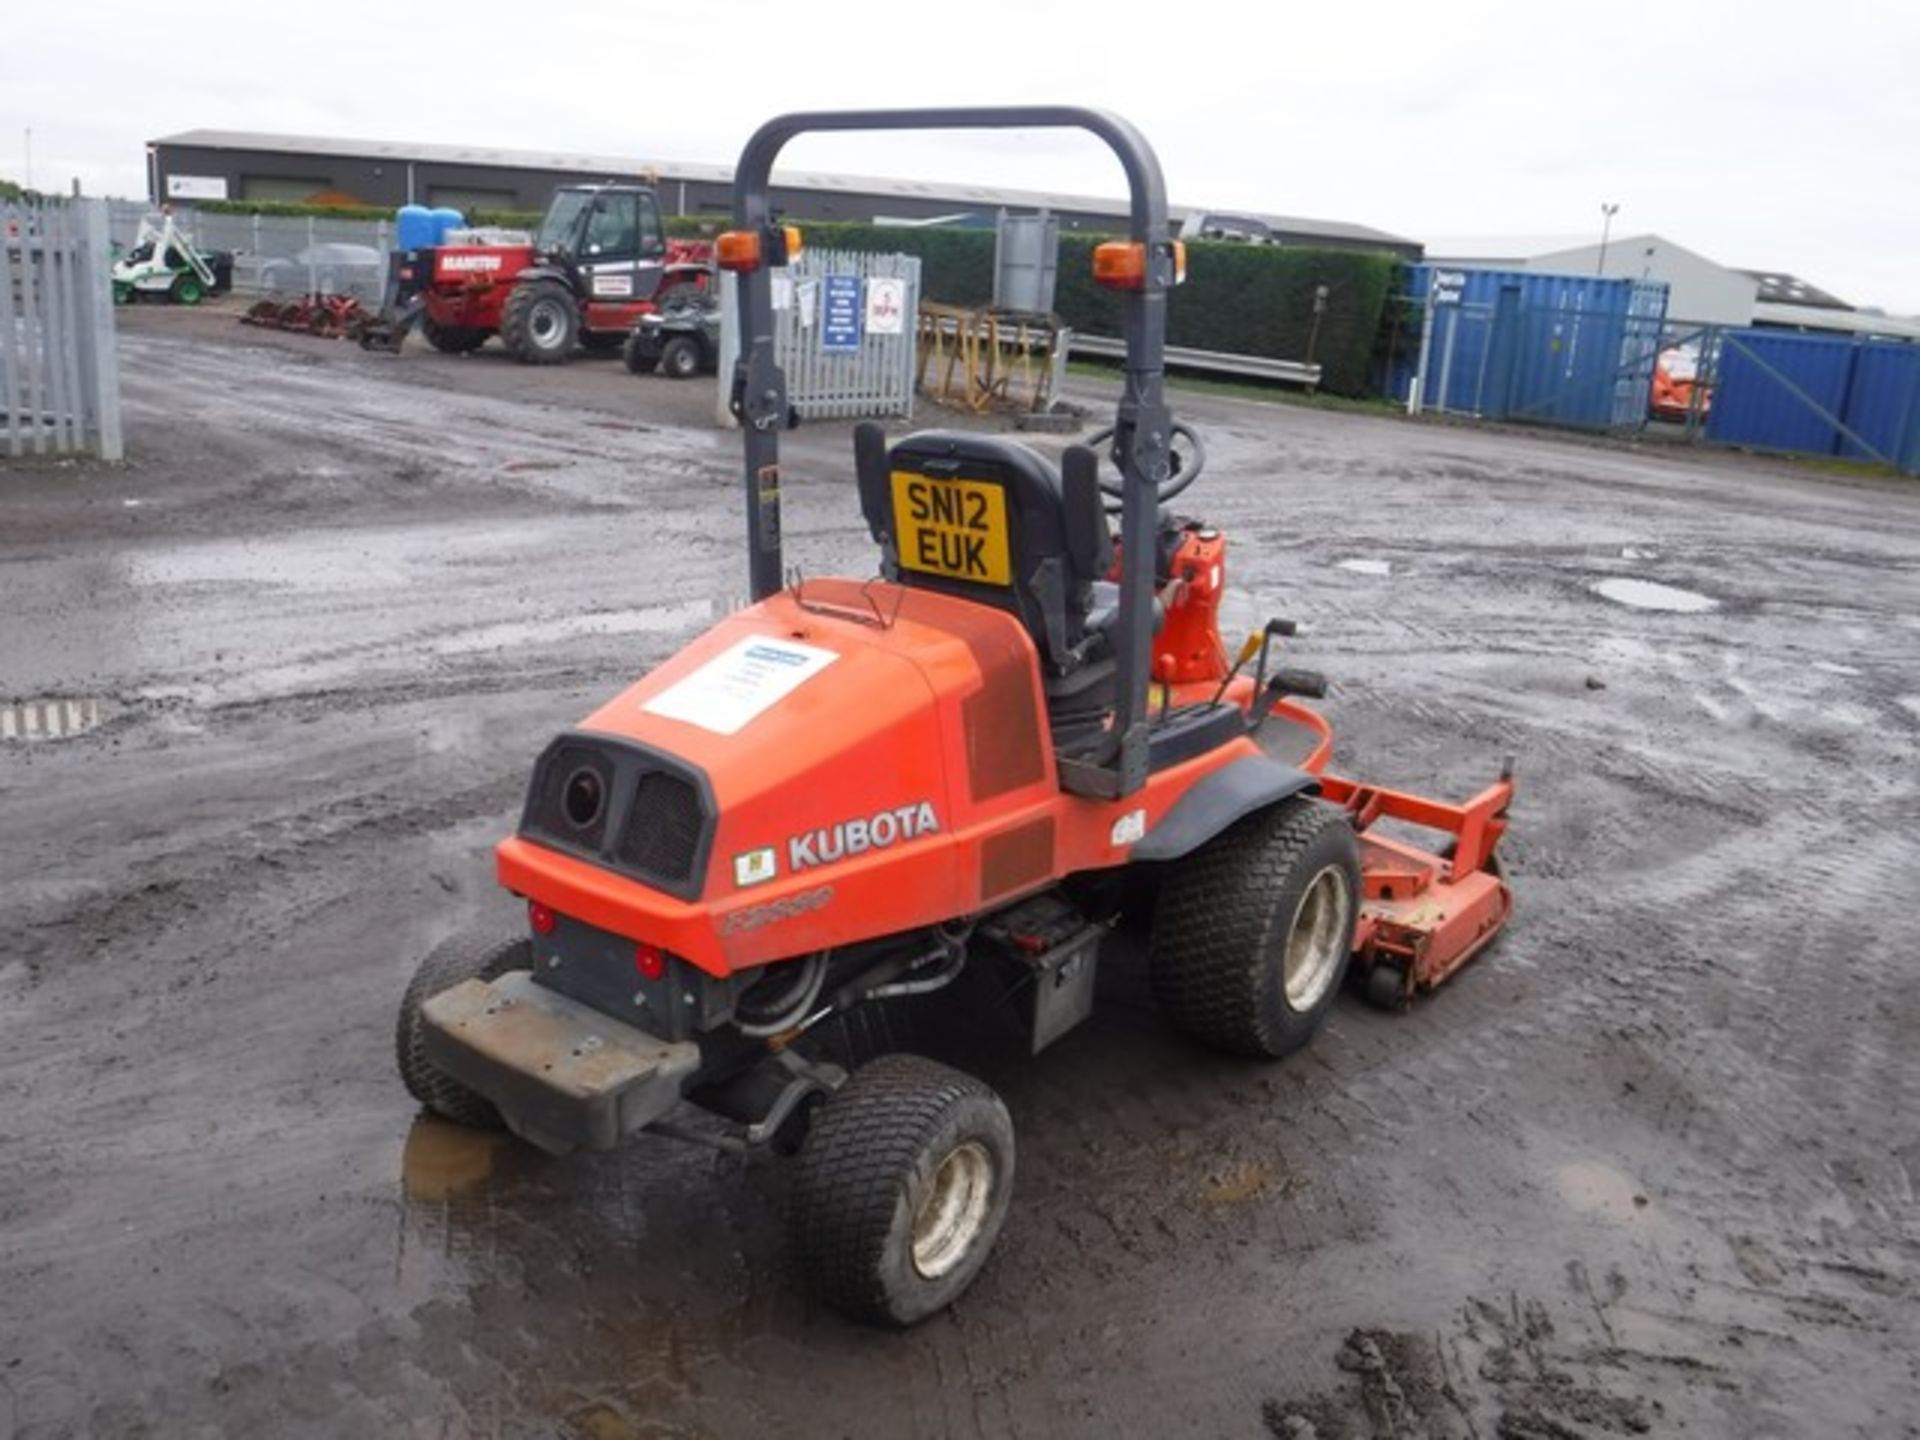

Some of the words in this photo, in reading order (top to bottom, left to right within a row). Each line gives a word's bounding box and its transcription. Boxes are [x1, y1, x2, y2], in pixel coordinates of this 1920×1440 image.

[908, 483, 989, 531] SN12
[918, 528, 988, 576] EUK
[789, 800, 939, 871] KUBOTA
